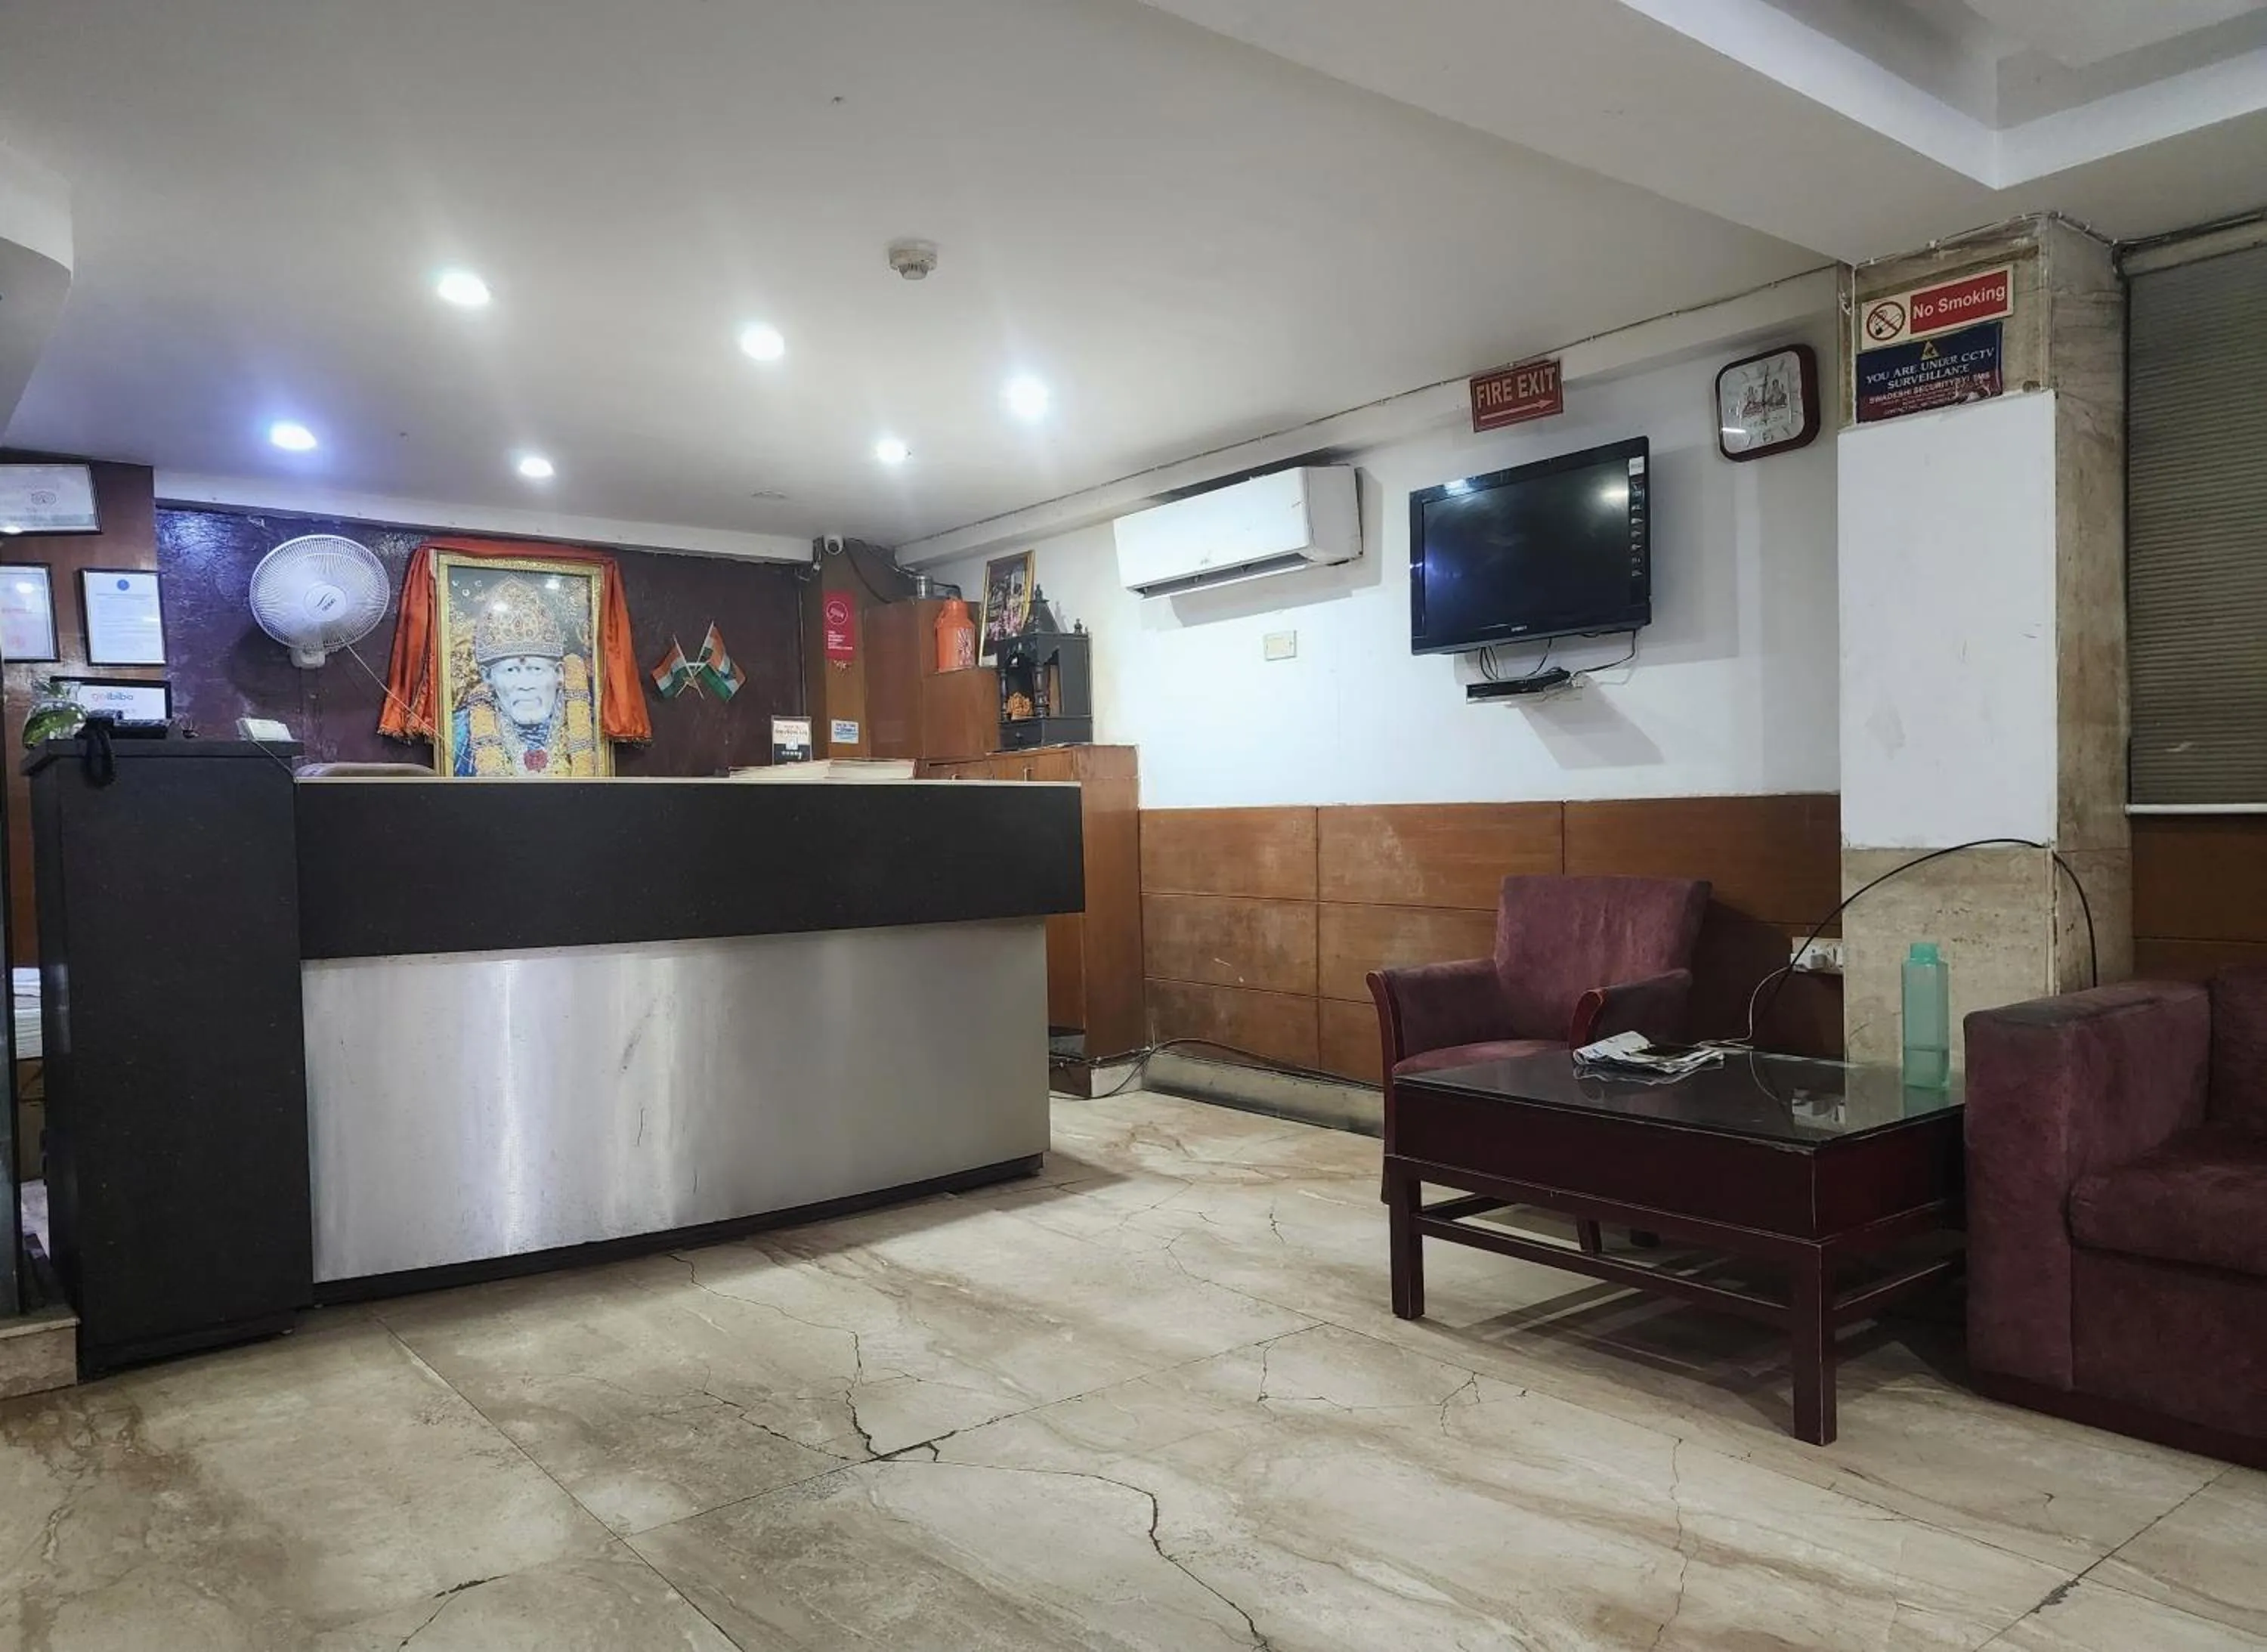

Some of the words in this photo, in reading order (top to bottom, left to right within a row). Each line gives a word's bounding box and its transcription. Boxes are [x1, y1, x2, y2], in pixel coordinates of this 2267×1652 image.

[1912, 304, 1934, 320] No
[1938, 285, 2006, 313] Smoking
[1866, 371, 1890, 384] YOU
[1893, 364, 1917, 377] ARE
[1920, 354, 1958, 370] UNDER
[1961, 347, 1995, 362] CCTV
[1476, 379, 1512, 408] FIRE
[1517, 367, 1555, 398] EXIT
